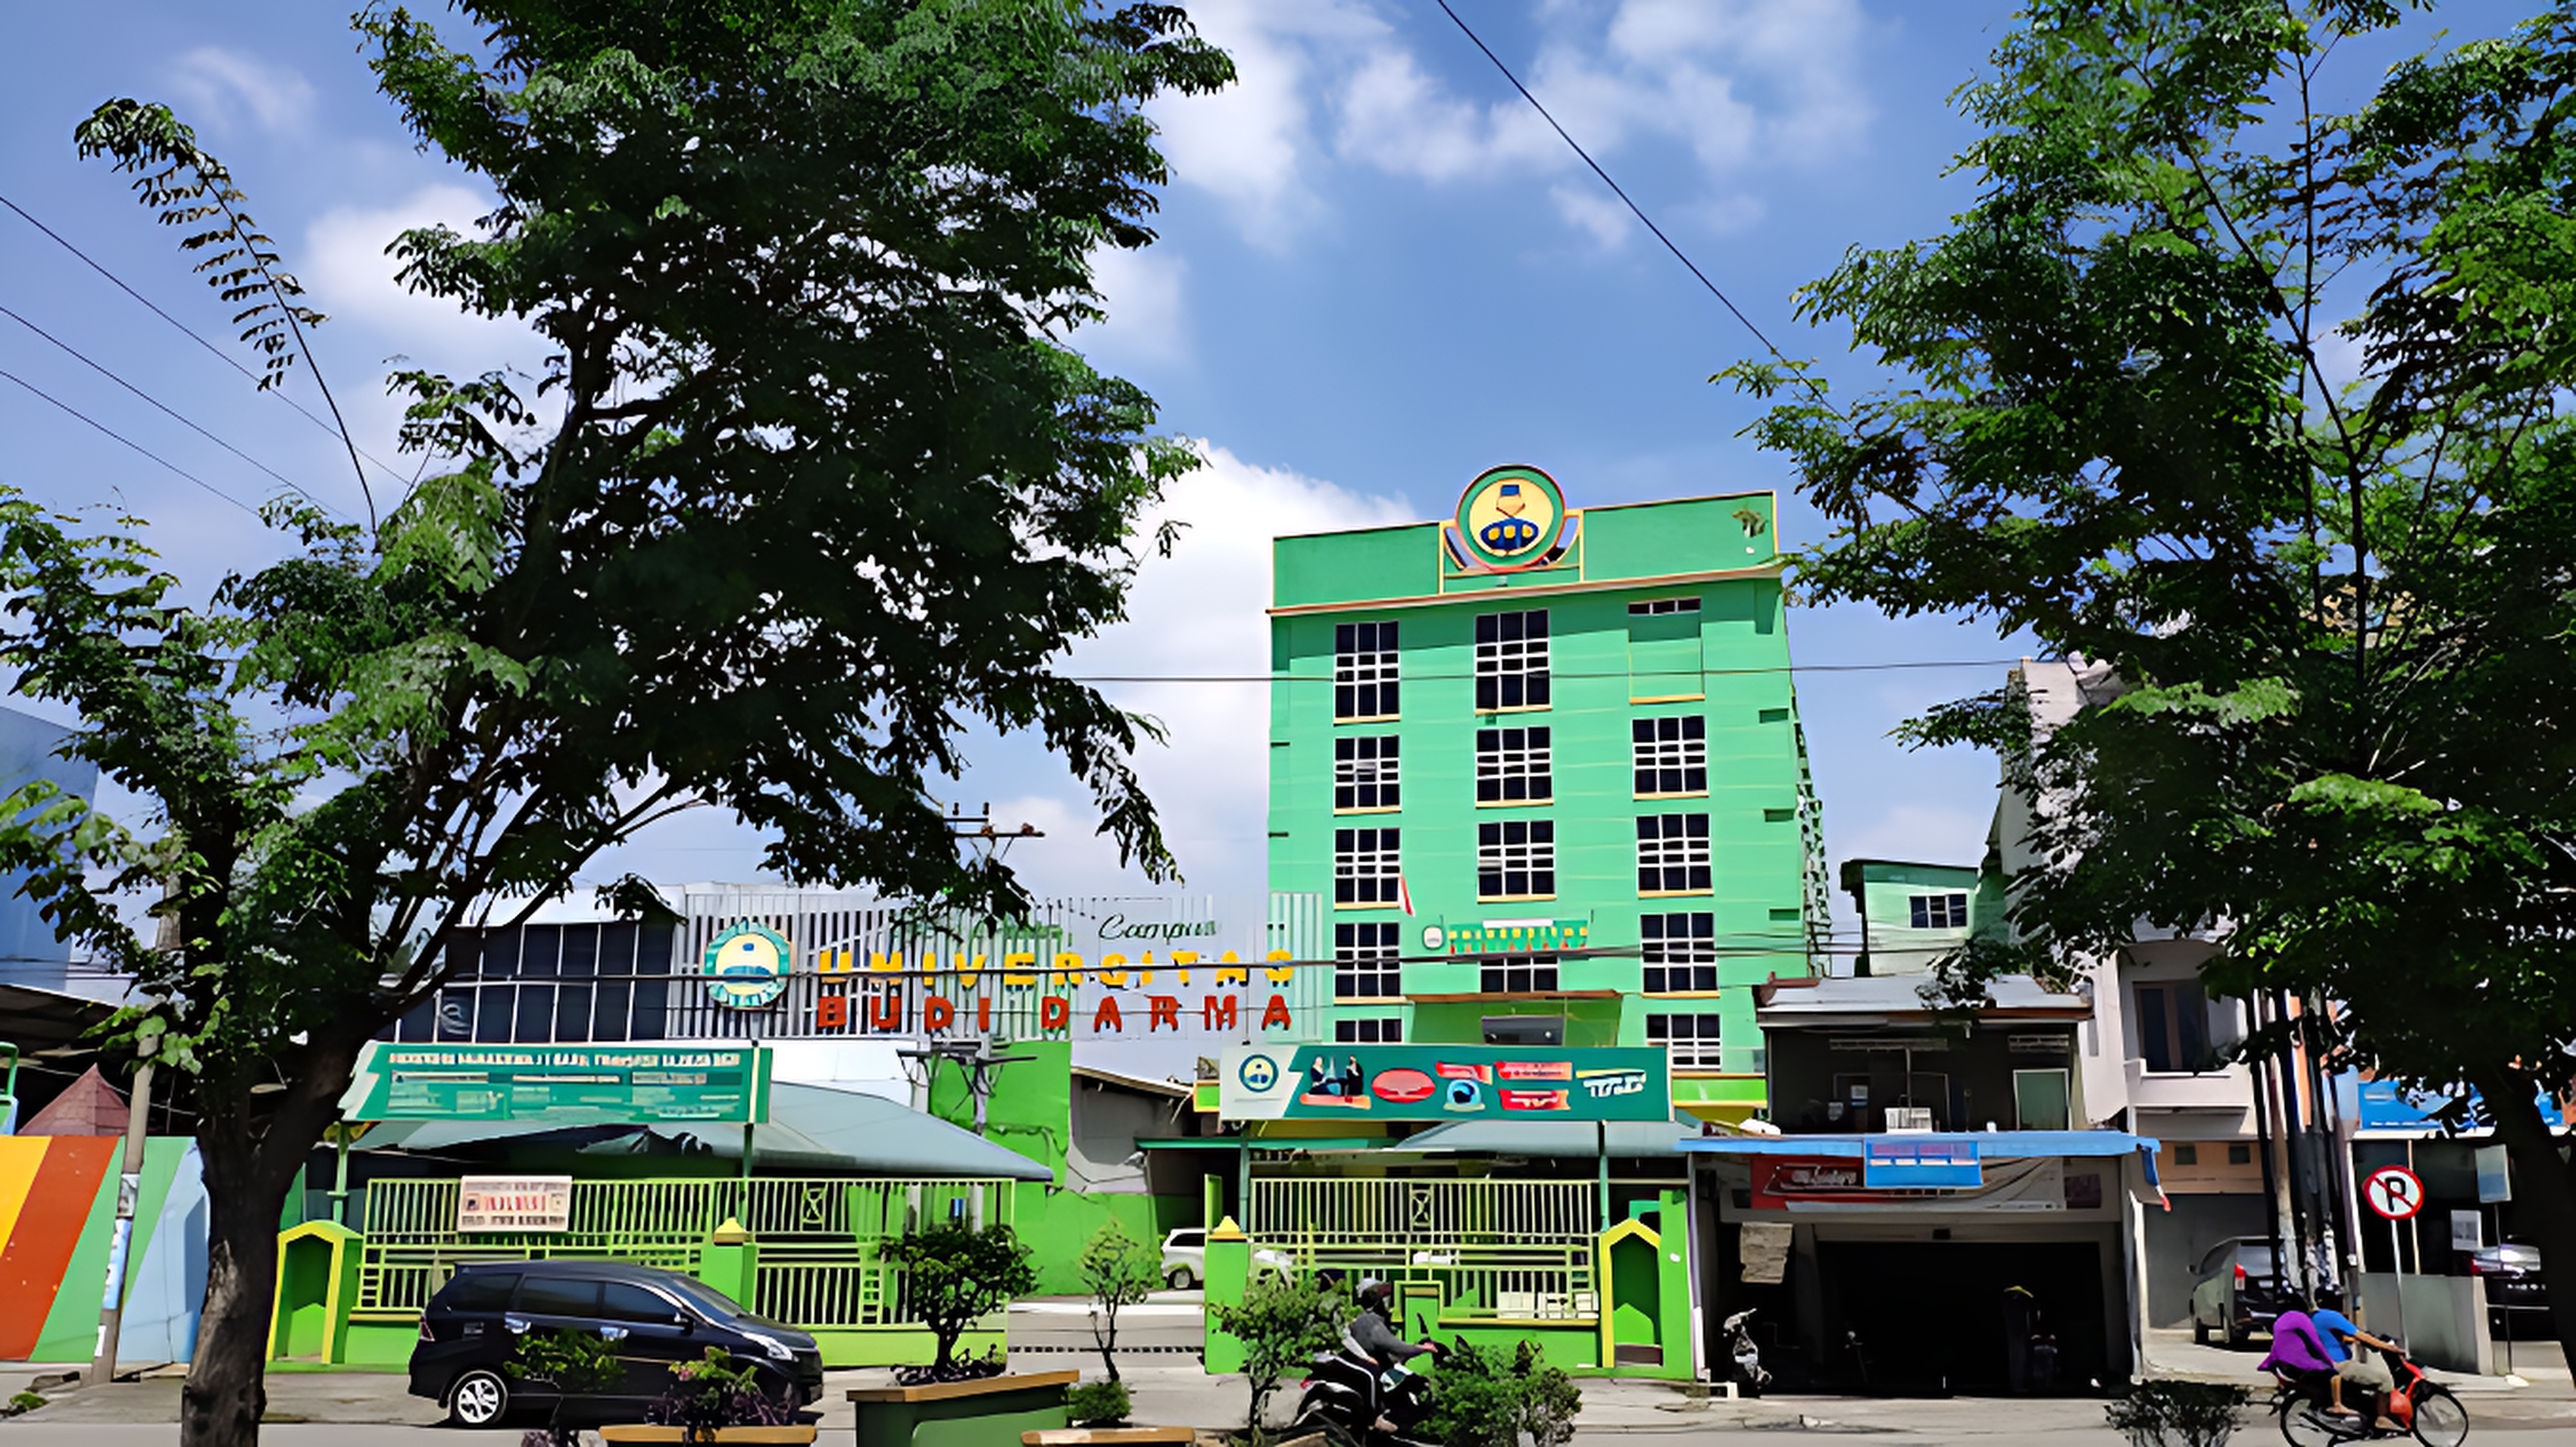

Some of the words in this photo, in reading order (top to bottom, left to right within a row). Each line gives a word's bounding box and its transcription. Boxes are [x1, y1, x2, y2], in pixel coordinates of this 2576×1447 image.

[818, 949, 1294, 987] UNIVERSITAS
[818, 995, 991, 1032] BUDI
[1041, 995, 1293, 1032] DARMA
[2386, 1177, 2406, 1212] P
